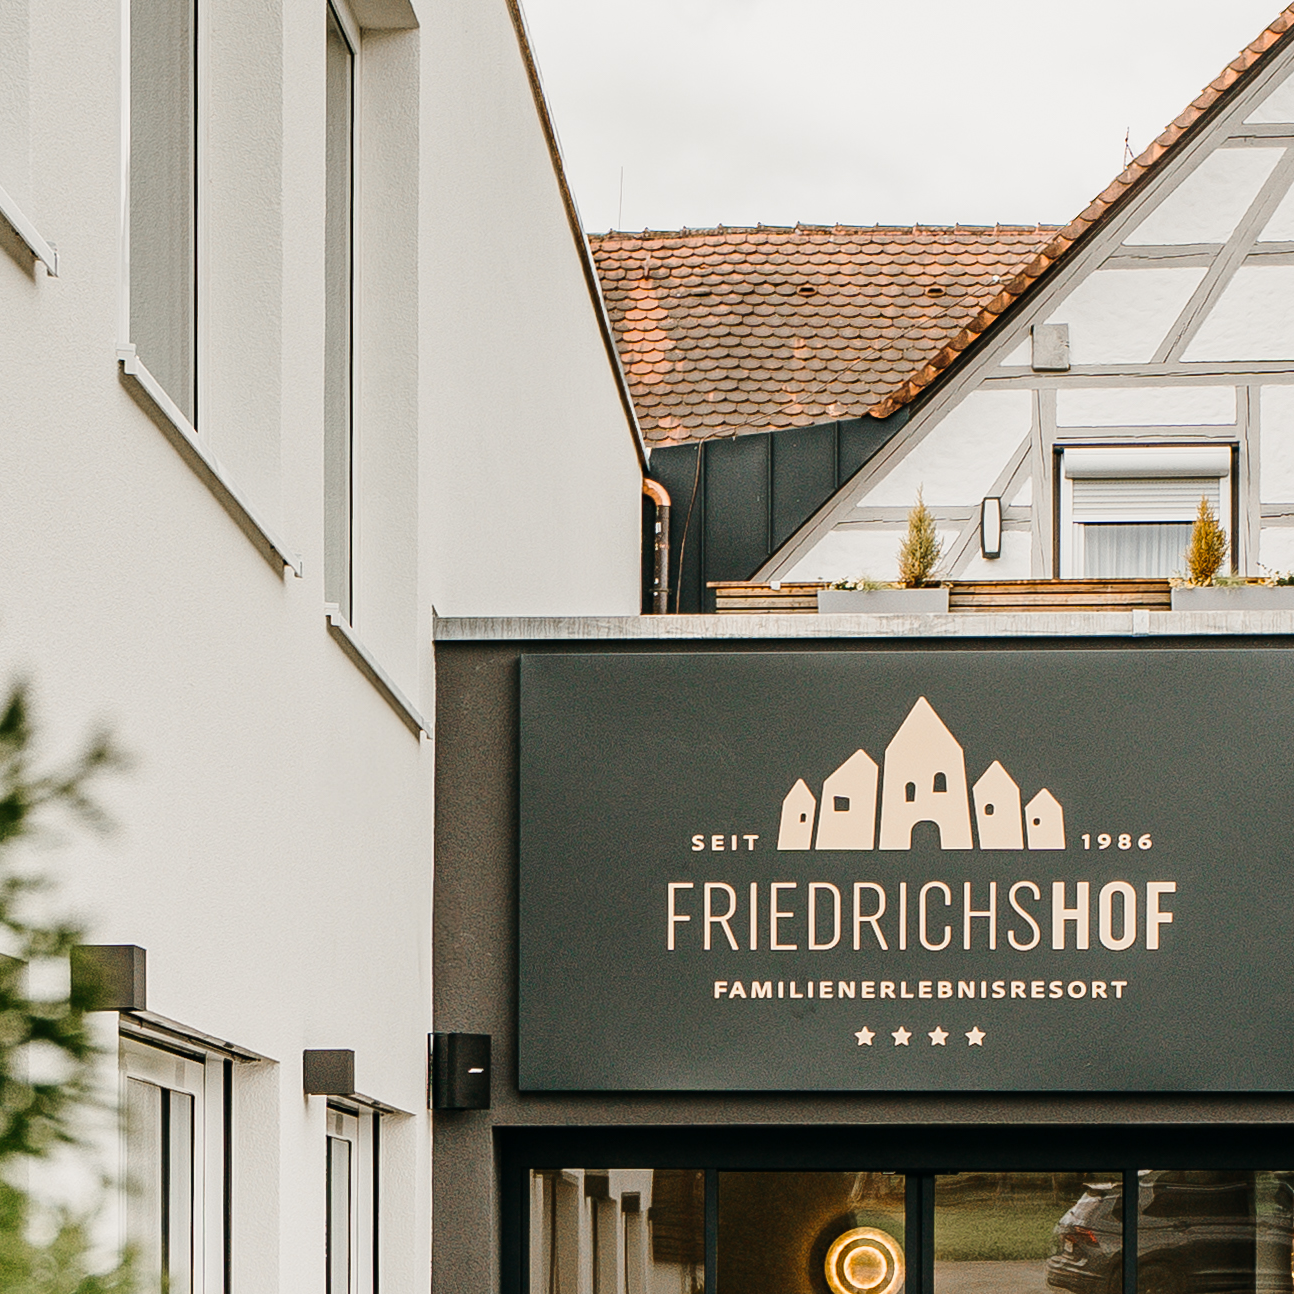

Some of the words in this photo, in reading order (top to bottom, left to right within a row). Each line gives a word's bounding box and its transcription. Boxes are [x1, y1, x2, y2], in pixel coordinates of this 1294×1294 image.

[692, 835, 759, 851] SEIT
[1082, 834, 1152, 849] 1986
[668, 881, 1176, 950] FRIEDRICHSHOF
[714, 981, 1127, 998] FAMILIENERLEBNISRESORT
